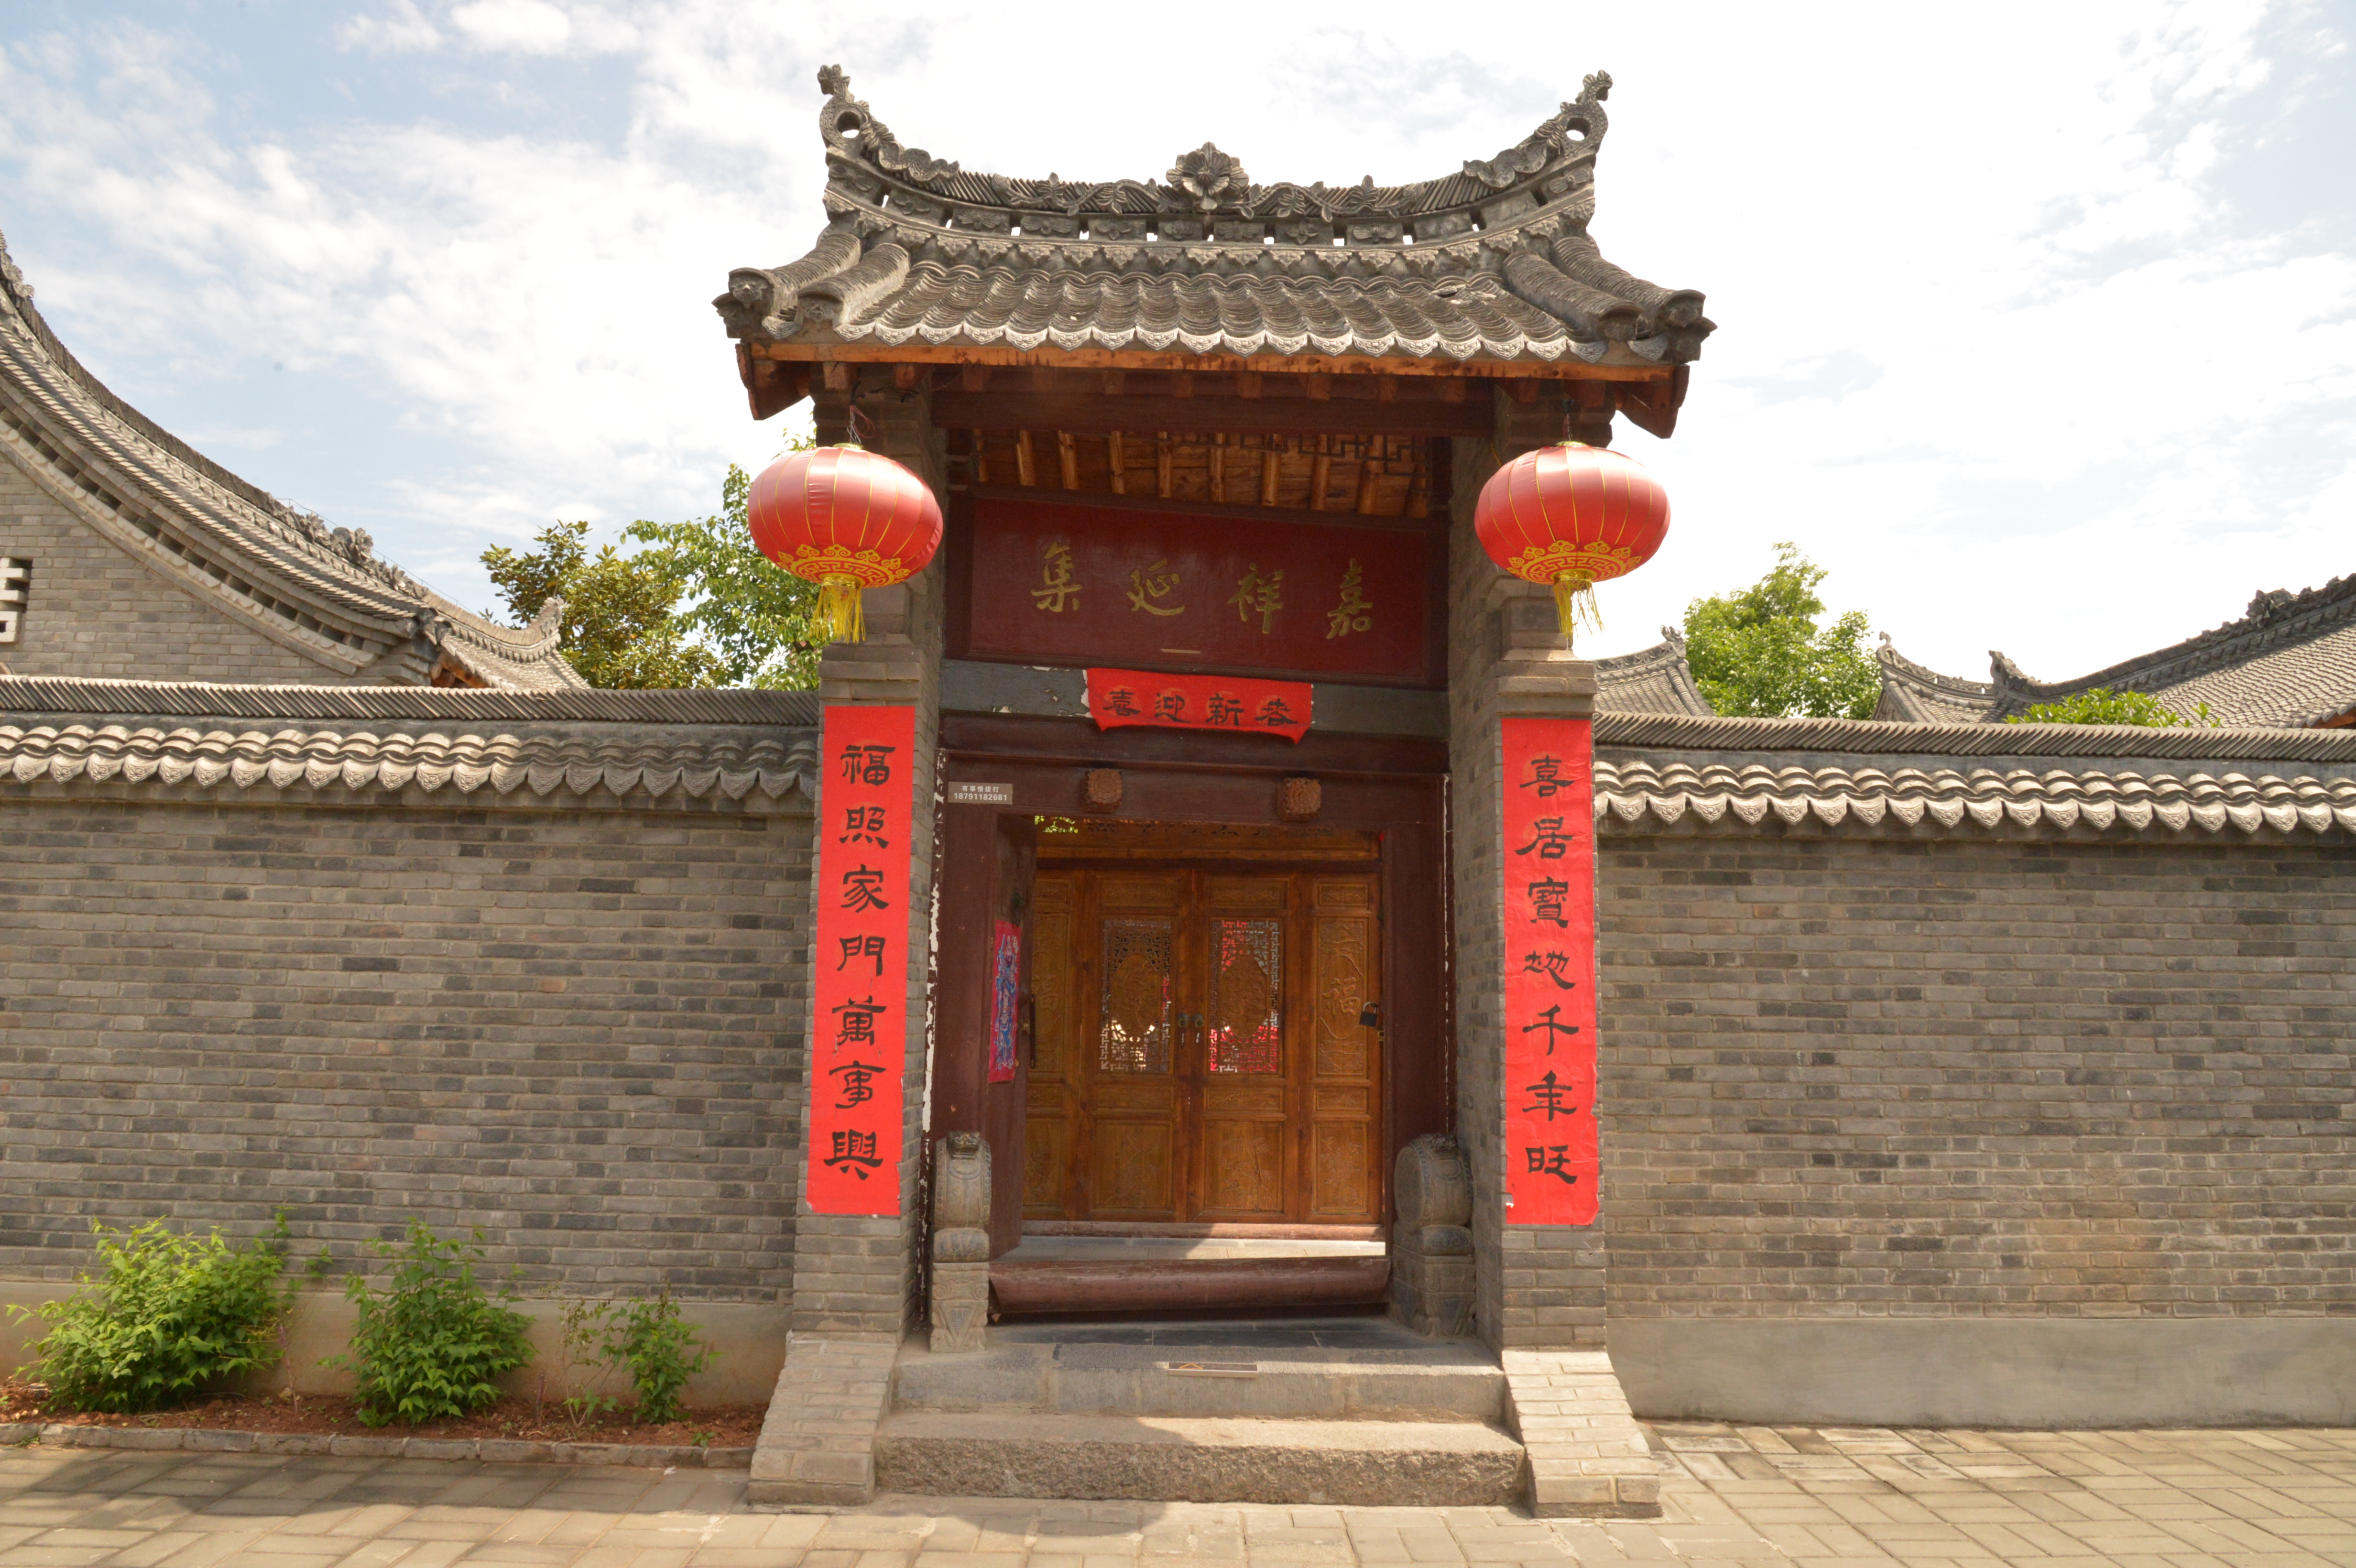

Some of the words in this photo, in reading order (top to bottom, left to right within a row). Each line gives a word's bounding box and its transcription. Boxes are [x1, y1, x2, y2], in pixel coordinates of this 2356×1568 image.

[1102, 689, 1298, 726] 喜迎新春
[1322, 977, 1361, 1016] 福
